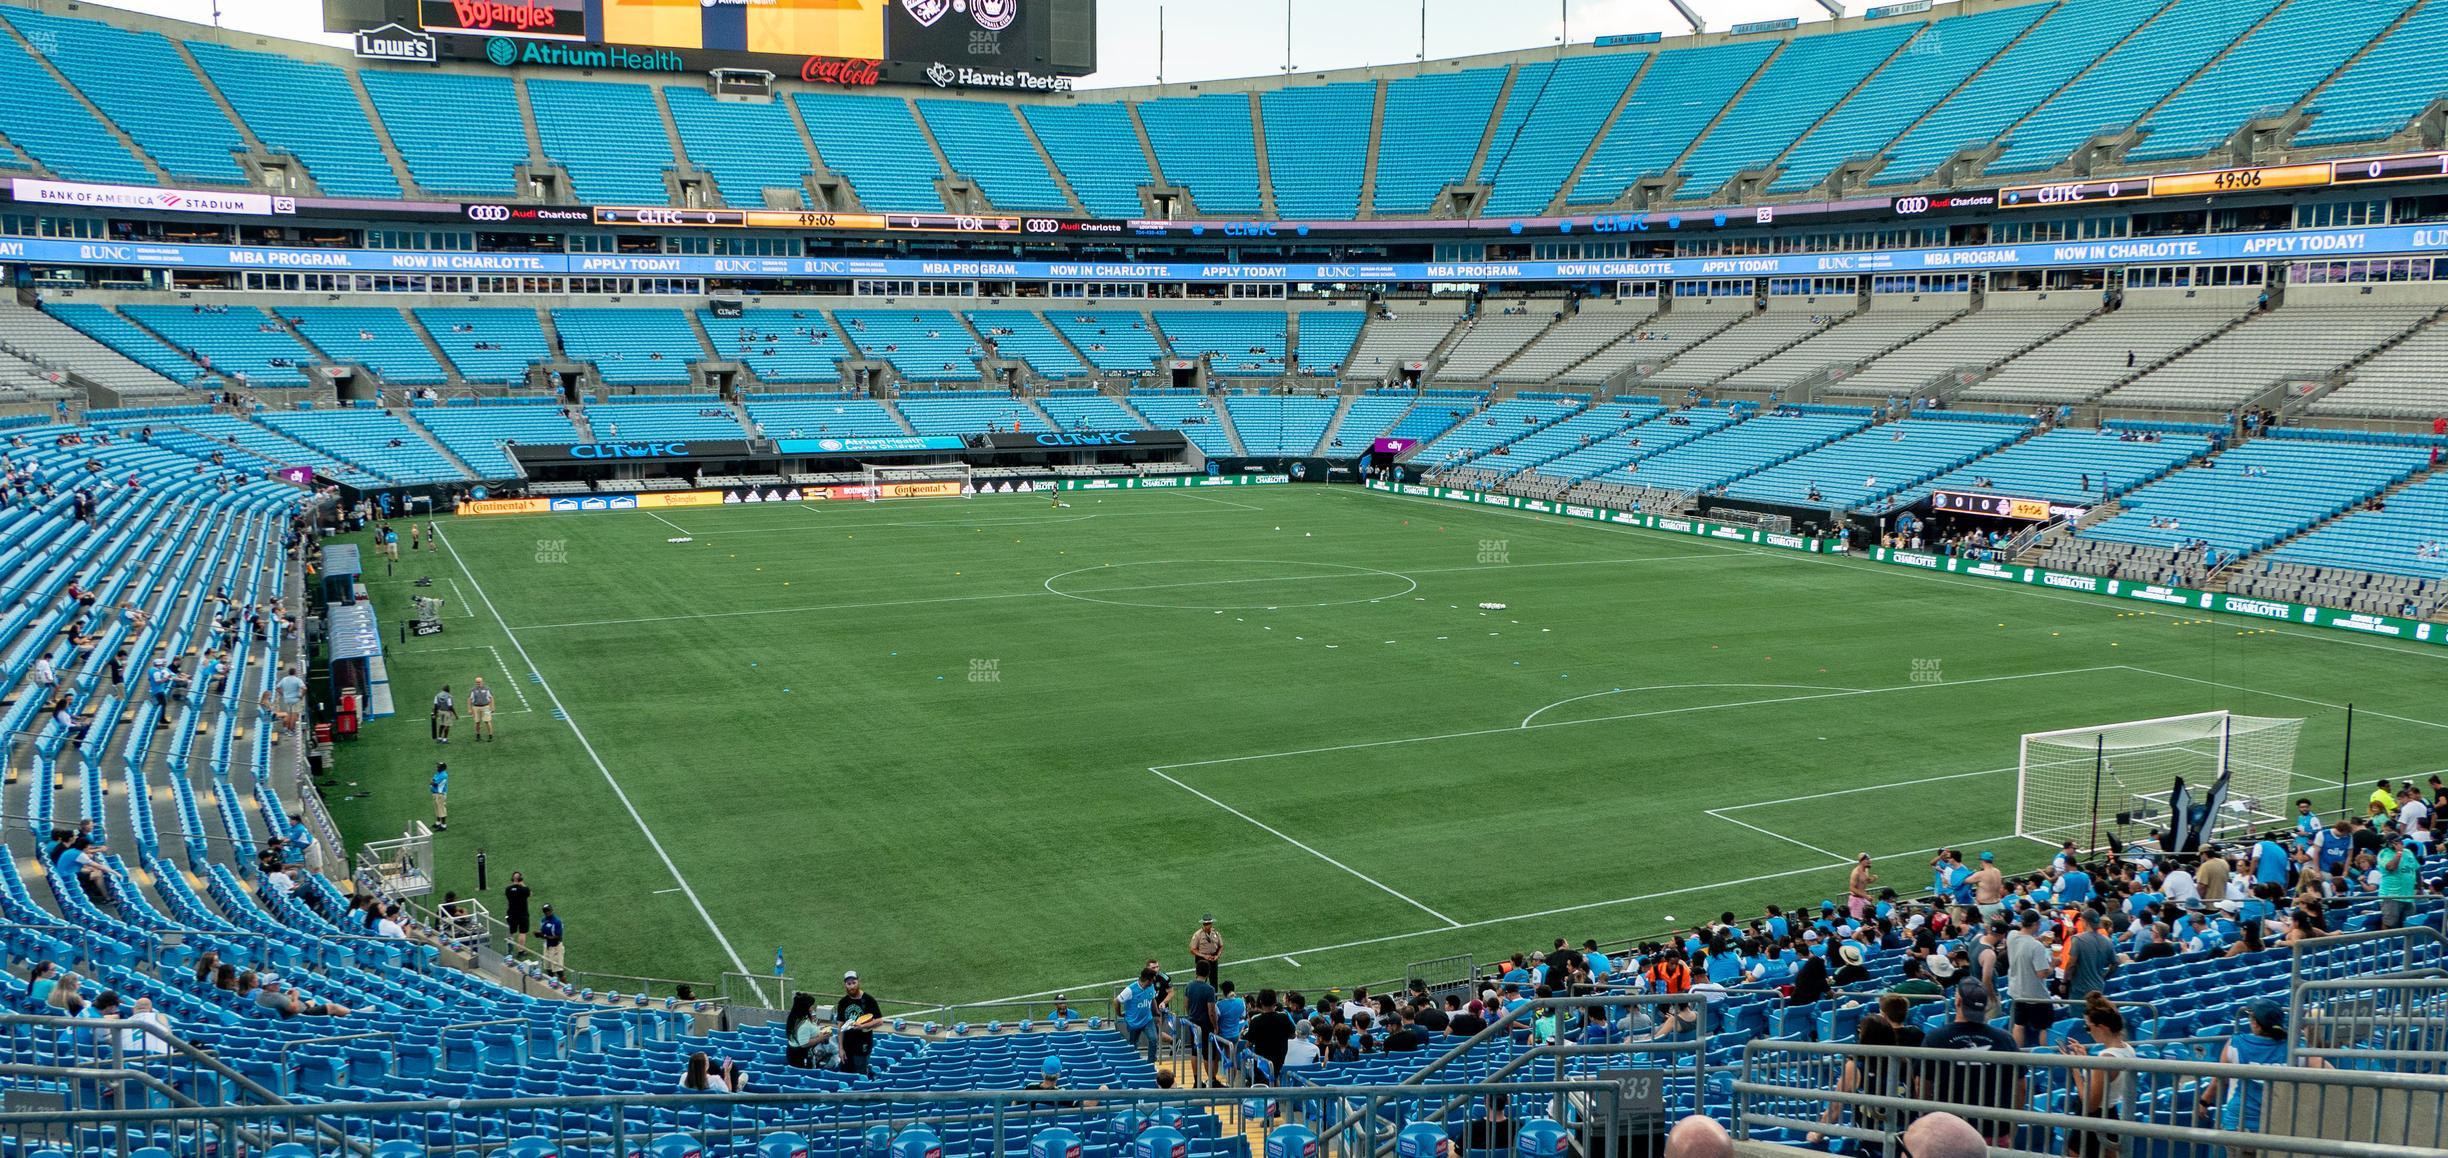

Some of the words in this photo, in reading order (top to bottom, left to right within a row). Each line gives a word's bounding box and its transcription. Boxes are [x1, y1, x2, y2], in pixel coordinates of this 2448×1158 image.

[362, 35, 428, 57] LOWE'S
[522, 42, 605, 67] Atrium
[610, 48, 683, 72] Health
[958, 69, 1014, 88] Harris
[1018, 73, 1071, 91] Teeter
[2369, 161, 2381, 177] 0
[2214, 171, 2261, 188] 49:06
[41, 189, 74, 200] BANK
[77, 191, 92, 201] OF
[96, 193, 154, 206] AMERICA
[186, 199, 244, 210] STADIUM
[2038, 185, 2084, 203] CLTFC
[2108, 183, 2119, 196] 0
[1930, 198, 1950, 208] Audi
[1950, 196, 1993, 207] Charlotte
[512, 209, 536, 218] Audi
[538, 210, 588, 220] Charlotte
[637, 211, 682, 223] CLTFC
[707, 212, 716, 223] 0
[799, 214, 835, 226] 49:06
[911, 217, 919, 228] 0
[955, 218, 983, 230] TOR
[1061, 223, 1080, 231] Audi
[1081, 223, 1121, 232] Charlotte
[2243, 237, 2296, 252] APPLY
[2300, 234, 2365, 250] TODAY!
[89, 246, 131, 260] UNC
[2055, 247, 2085, 260] NOW
[2088, 246, 2104, 259] IN
[2108, 242, 2201, 258] CHARLOTTE.
[230, 251, 266, 265] MBA
[269, 252, 351, 267] PROGRAM.
[392, 255, 429, 266] NOW
[432, 256, 450, 267] IN
[453, 256, 545, 269] CHARLOTTE.
[584, 258, 628, 270] APPLY
[630, 259, 680, 271] TODAY!
[1824, 257, 1854, 268] UNC
[1924, 253, 1952, 265] MBA
[1954, 251, 2019, 264] PROGRAM.
[722, 261, 757, 273] UNC
[813, 262, 845, 273] UNC
[923, 264, 952, 274] MBA
[954, 264, 1018, 275] PROGRAM.
[1050, 265, 1077, 275] NOW
[1080, 266, 1093, 276] IN
[1096, 266, 1171, 277] CHARLOTTE.
[1202, 267, 1240, 277] APPLY
[1242, 267, 1286, 277] TODAY!
[1324, 267, 1355, 277] UNC
[1427, 267, 1455, 277] MBA
[1458, 266, 1521, 277] PROGRAM.
[1557, 265, 1581, 276] NOW
[1585, 265, 1600, 275] IN
[1603, 263, 1674, 275] CHARLOTTE.
[1702, 261, 1736, 273] APPLY
[1738, 259, 1779, 272] TODAY!
[845, 438, 883, 446] Atrium
[885, 437, 924, 445] Health
[1388, 442, 1402, 451] ally
[1142, 480, 1177, 488] CHARLOTTE
[895, 485, 940, 497] Continental
[473, 500, 529, 513] Continental
[1956, 497, 1963, 508] 0
[1982, 499, 1989, 510] 0
[2017, 504, 2042, 515] 49:06
[1893, 554, 1936, 568] CHARLOTTE
[2044, 575, 2096, 591] CHARLOTTE
[2225, 601, 2289, 618] CHARLOTTE
[1137, 999, 1152, 1009] ally
